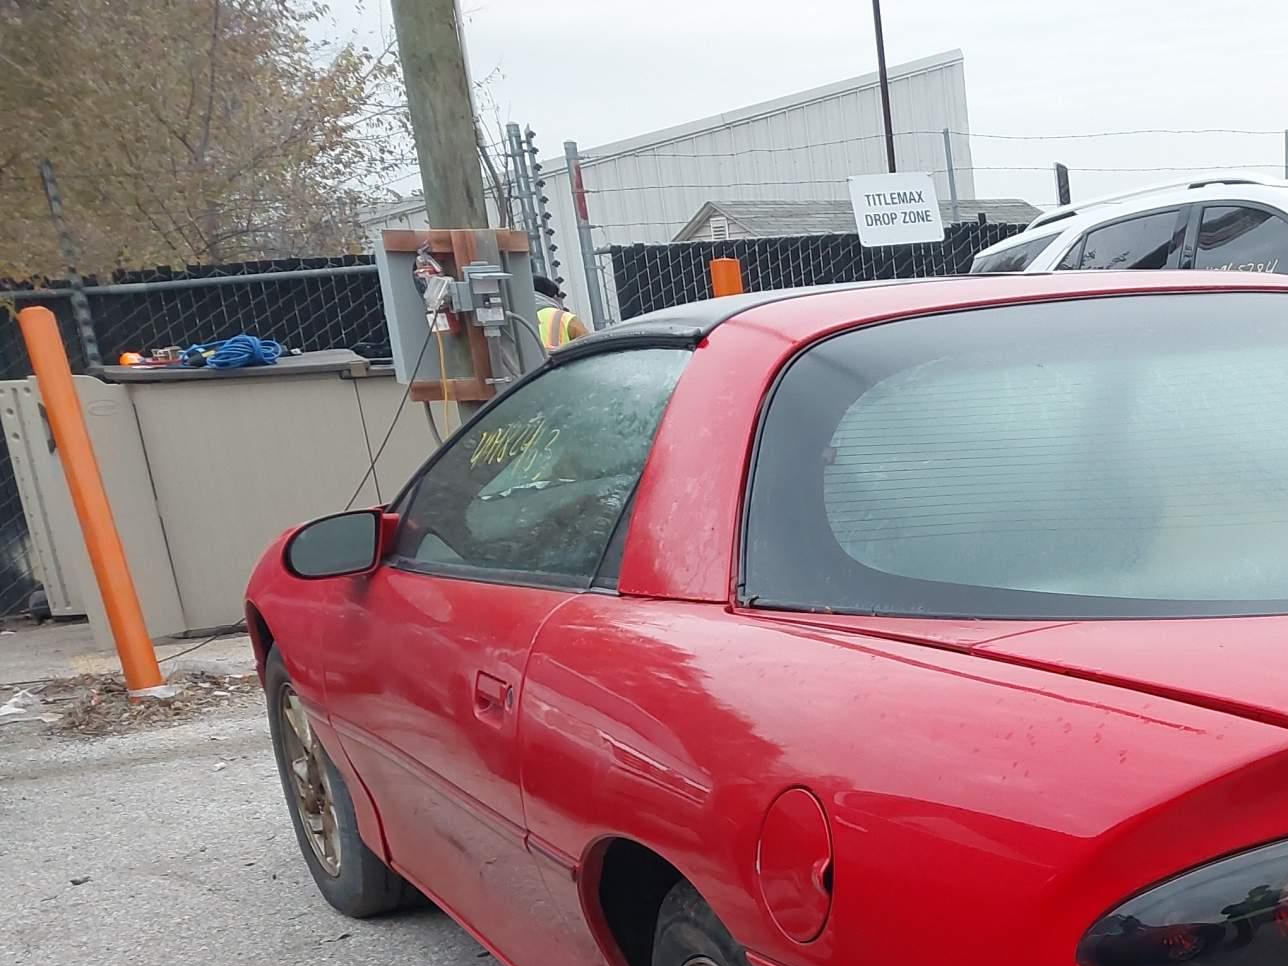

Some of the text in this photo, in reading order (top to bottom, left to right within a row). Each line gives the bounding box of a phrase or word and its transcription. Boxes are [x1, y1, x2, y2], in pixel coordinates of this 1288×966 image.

[864, 190, 925, 207] TITLEMAX
[865, 210, 933, 227] DROP ZONE
